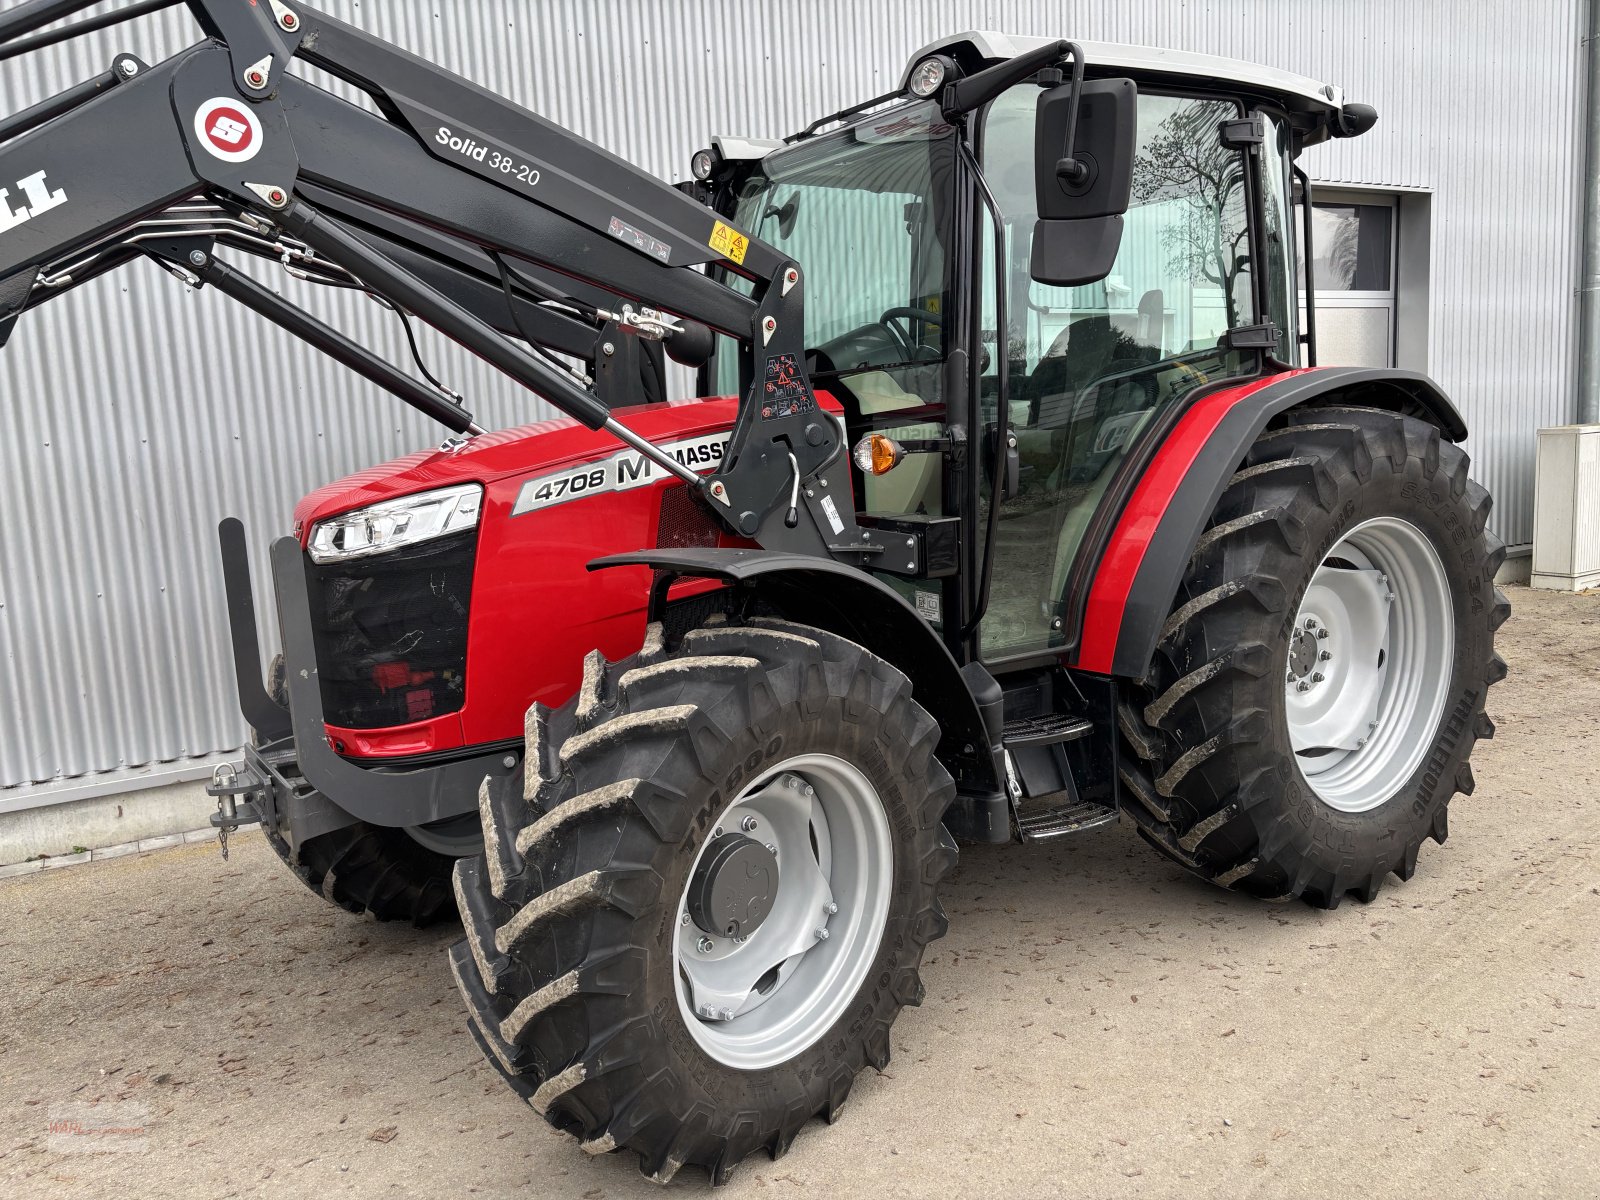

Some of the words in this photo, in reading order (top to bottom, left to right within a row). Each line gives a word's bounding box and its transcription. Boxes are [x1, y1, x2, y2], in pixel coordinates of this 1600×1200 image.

[435, 126, 488, 162] Solid
[489, 152, 540, 186] 38-20
[533, 469, 606, 501] 4708
[1406, 686, 1478, 822] TRELLEBORG
